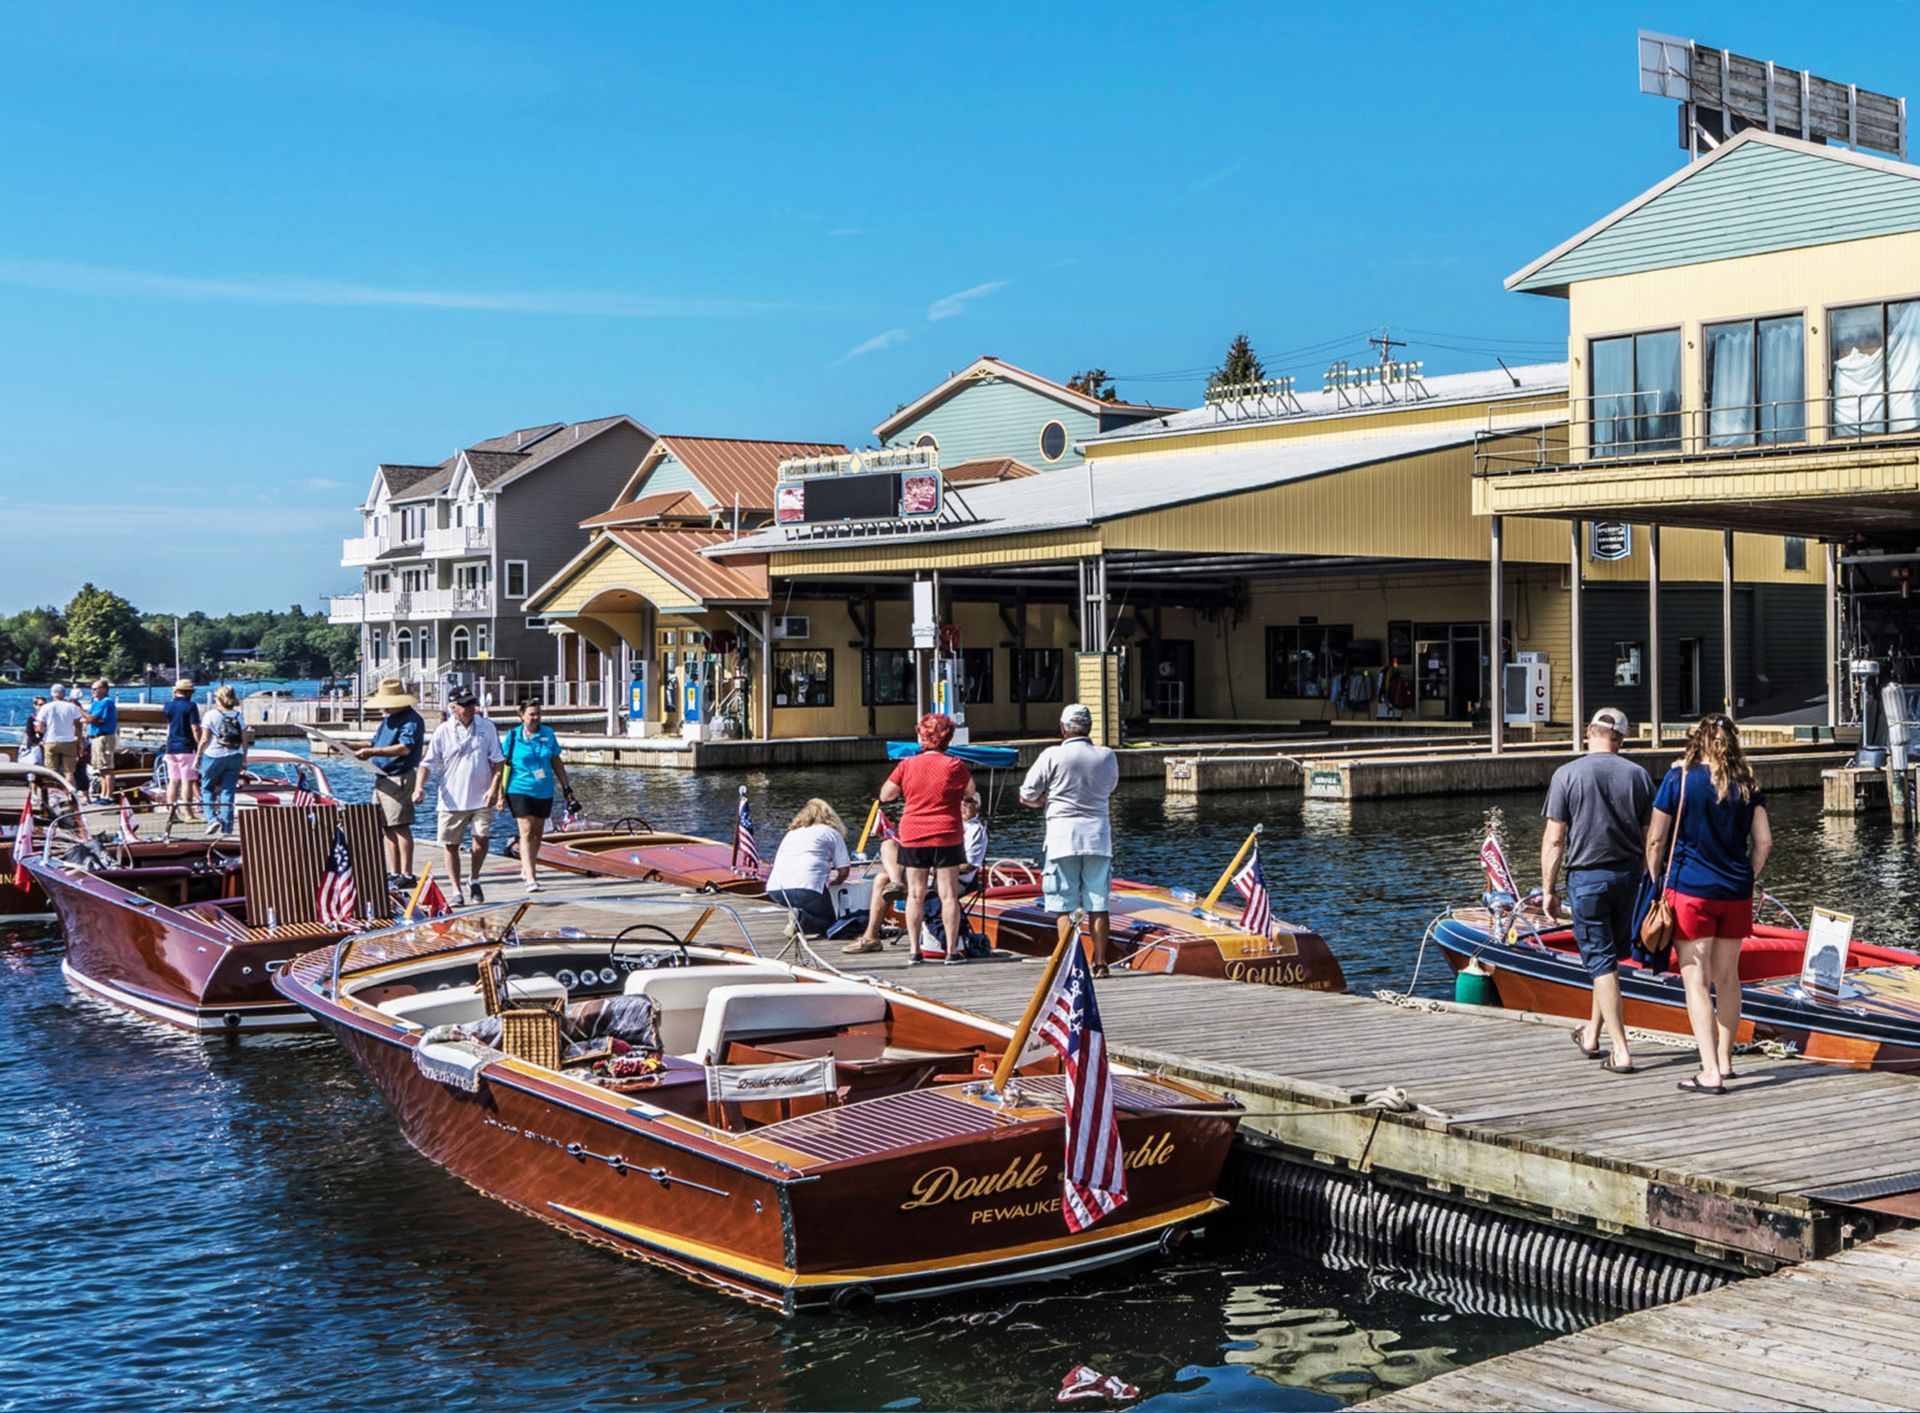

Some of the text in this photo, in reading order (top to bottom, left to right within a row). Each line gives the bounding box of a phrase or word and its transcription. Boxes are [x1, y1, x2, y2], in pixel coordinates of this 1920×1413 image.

[1520, 656, 1533, 664] ICE
[1535, 667, 1545, 716] ICE
[1225, 957, 1307, 985] Louise
[901, 1152, 1048, 1211] Double
[970, 1197, 1062, 1225] PEWAUKE
